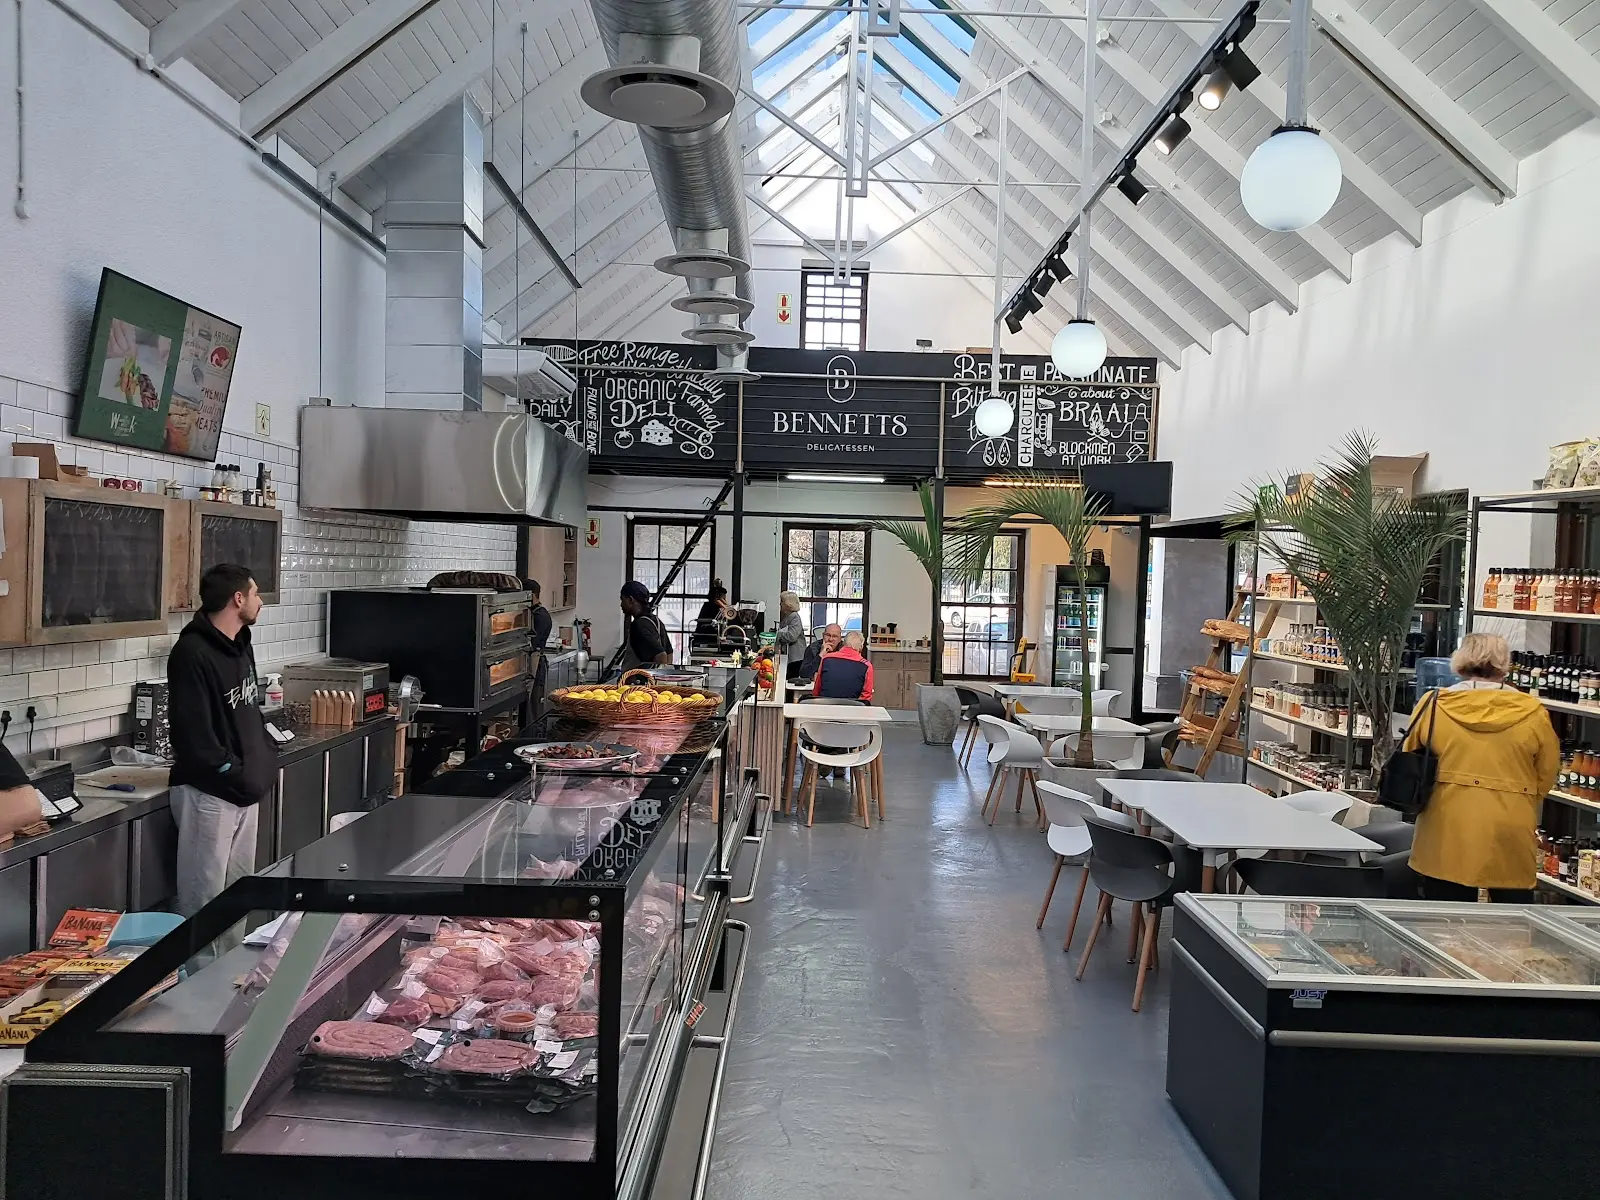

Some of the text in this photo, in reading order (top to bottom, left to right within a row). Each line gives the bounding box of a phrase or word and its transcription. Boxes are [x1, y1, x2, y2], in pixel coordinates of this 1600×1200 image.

[579, 341, 680, 367] Free Range
[833, 368, 850, 390] B
[953, 354, 1015, 386] BET
[1044, 362, 1150, 384] PAONATE
[951, 386, 1017, 418] Biltng
[1080, 385, 1116, 399] about
[530, 402, 572, 418] DAILY
[605, 377, 725, 434] ORGANIC Farmed
[609, 399, 676, 428] DELI
[1059, 400, 1130, 428] BRAAI
[772, 411, 908, 437] BENNETTS
[806, 443, 876, 453] DELICATESSEN
[1059, 441, 1116, 455] BLOCKMEN
[1061, 454, 1076, 466] AT
[1289, 989, 1328, 1000] JUST
